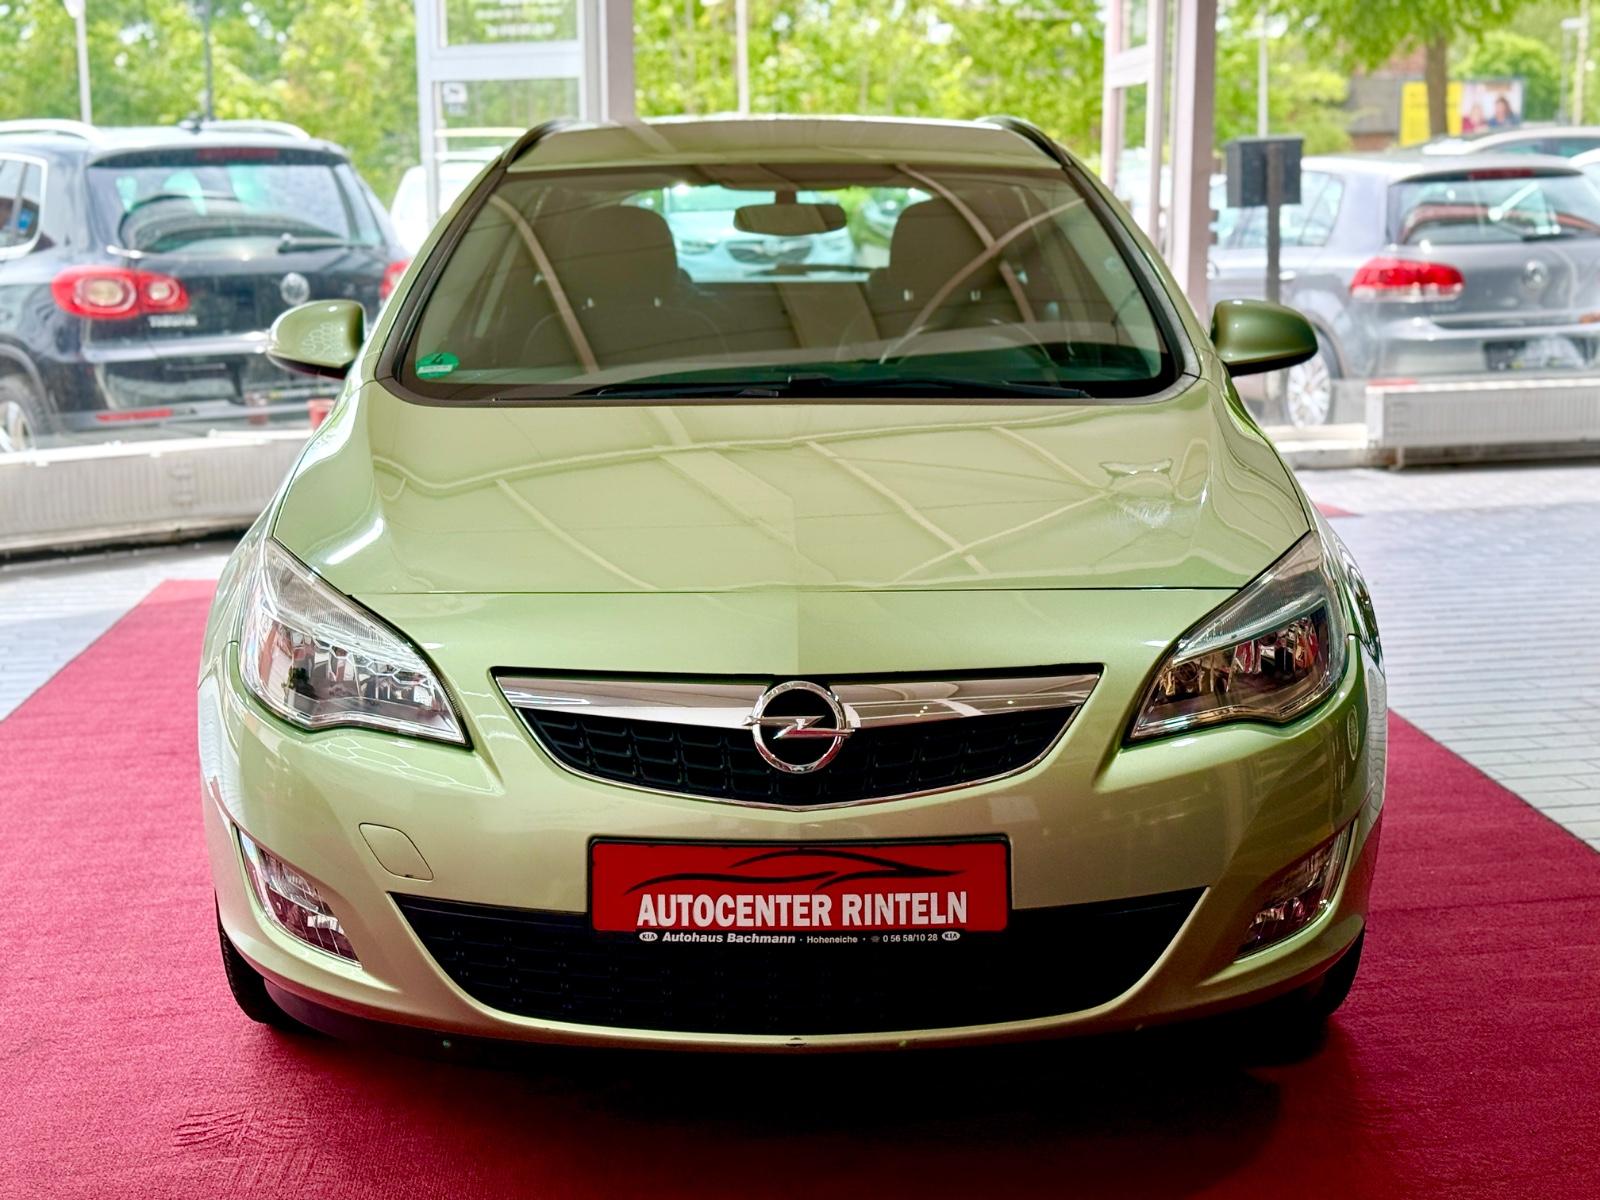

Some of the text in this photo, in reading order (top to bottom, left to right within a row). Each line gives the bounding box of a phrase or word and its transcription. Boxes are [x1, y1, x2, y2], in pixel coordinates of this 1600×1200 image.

[636, 891, 967, 927] AUTOCENTER RINTELN
[640, 932, 658, 941] KIA
[662, 932, 723, 942] Autohaus
[727, 933, 796, 943] Bachmann
[807, 935, 858, 943] Hoheneiche
